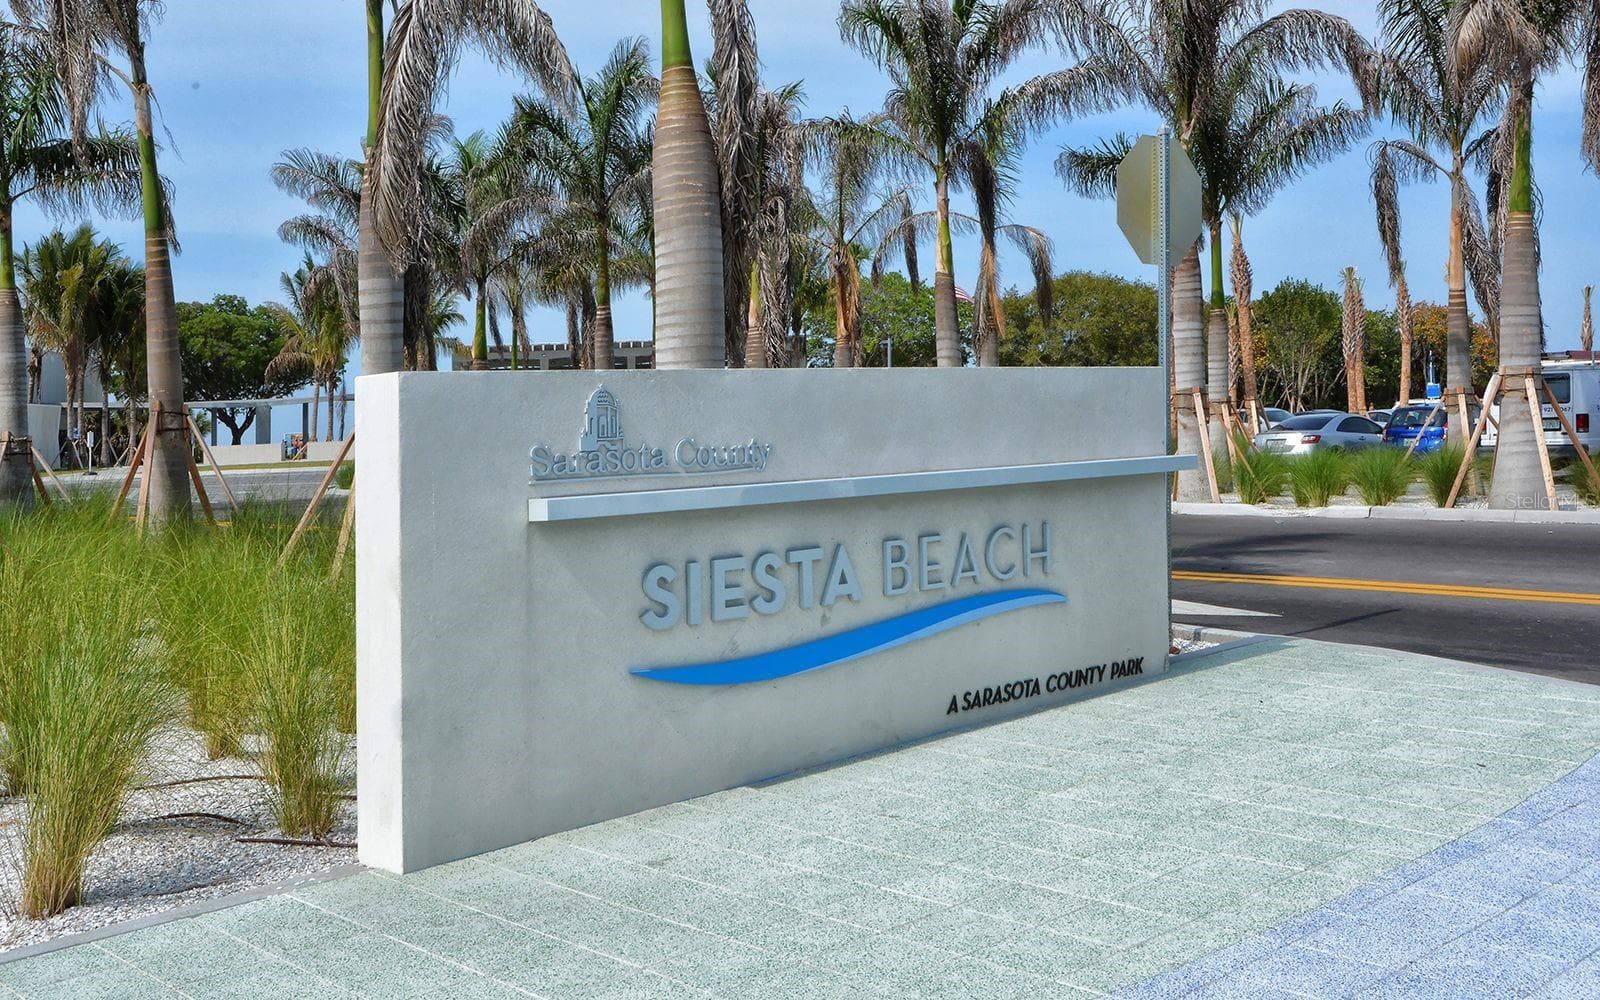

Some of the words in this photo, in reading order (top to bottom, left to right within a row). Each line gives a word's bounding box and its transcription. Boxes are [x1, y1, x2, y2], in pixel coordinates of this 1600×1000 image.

[530, 442, 669, 477] Sarasota
[674, 436, 772, 472] County
[639, 543, 863, 631] SIESTA
[881, 521, 1053, 597] BEACH
[947, 695, 958, 715] A
[962, 678, 1040, 711] SARASOTA
[1046, 664, 1107, 693] COUNTY
[1110, 657, 1144, 680] PARK
